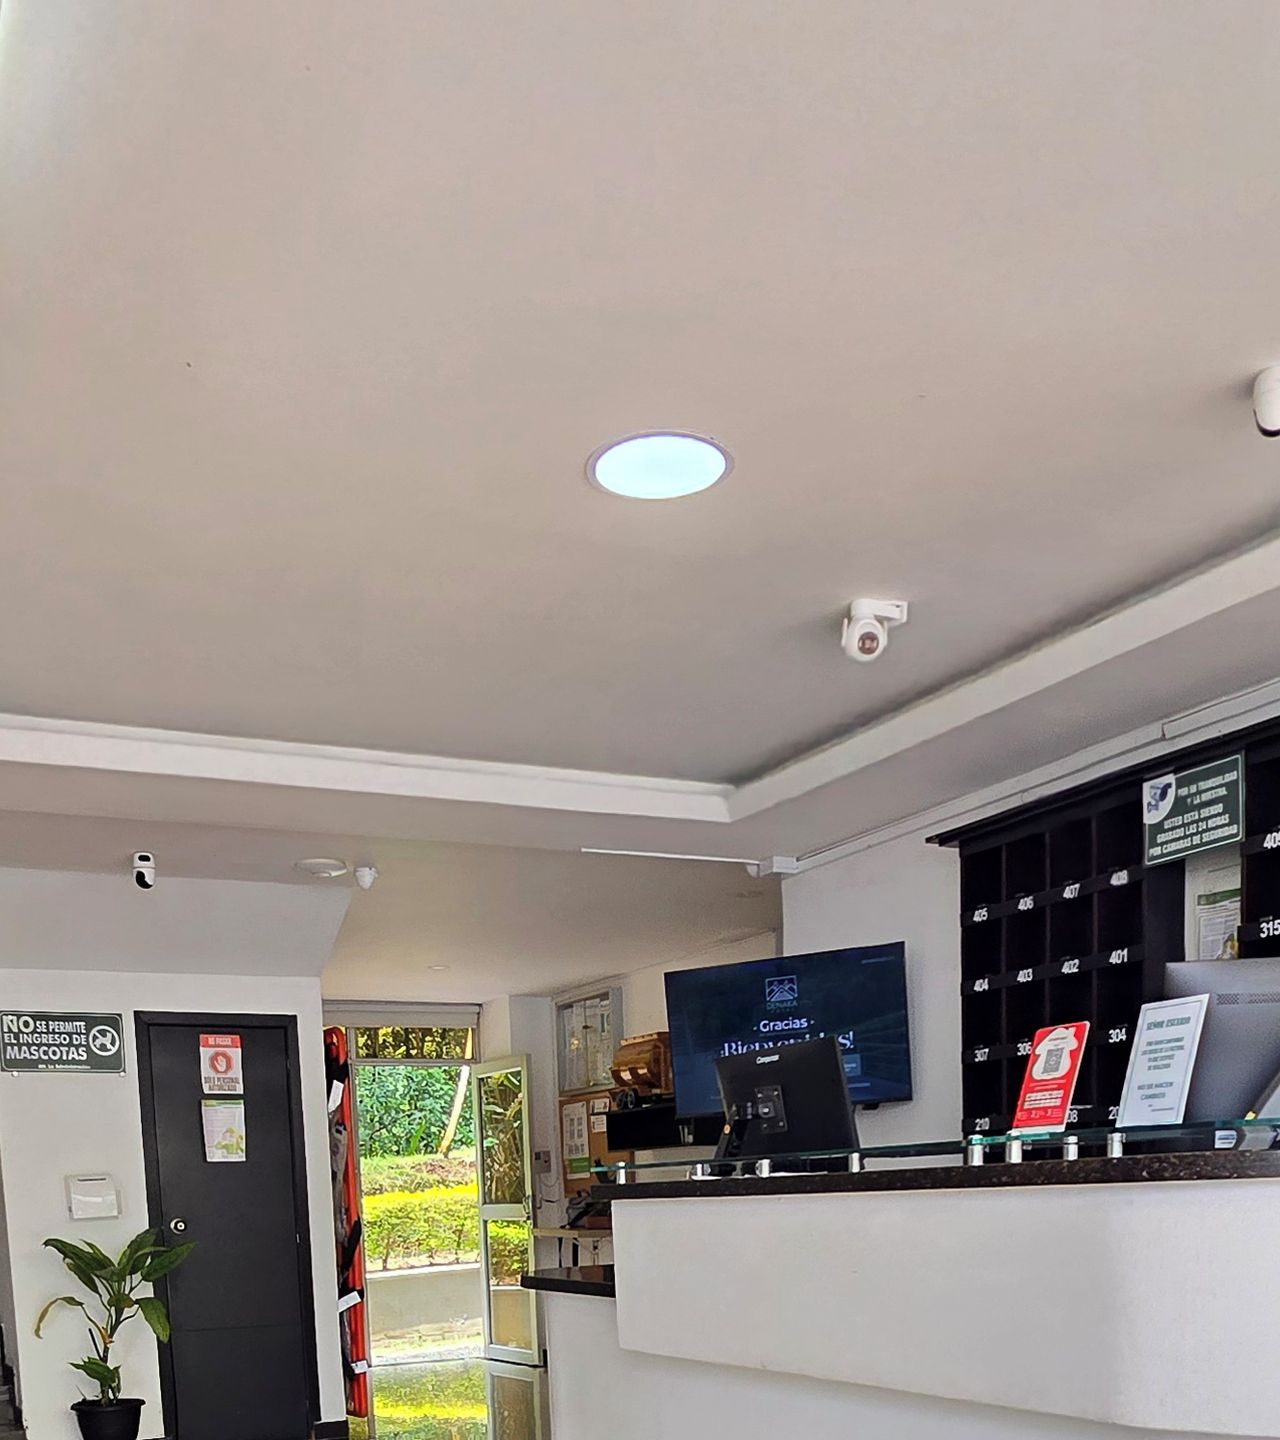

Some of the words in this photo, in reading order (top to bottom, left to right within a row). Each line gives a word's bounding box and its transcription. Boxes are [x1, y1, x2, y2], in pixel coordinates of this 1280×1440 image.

[1110, 869, 1128, 886] 408
[1063, 883, 1081, 899] 407
[1018, 896, 1034, 911] 406
[973, 908, 988, 922] 405
[1109, 948, 1128, 964] 401
[1061, 959, 1079, 974] 402
[1017, 968, 1033, 983] 403
[973, 978, 989, 992] 404
[1, 1014, 35, 1033] NO
[35, 1020, 47, 1033] SE
[48, 1021, 86, 1033] PERMITE
[759, 1017, 808, 1033] Gracias
[4, 1033, 17, 1043] EL
[19, 1033, 70, 1044] INGRESO
[72, 1034, 87, 1045] DE
[1108, 1028, 1127, 1042] 304
[5, 1045, 87, 1061] MASCOTAS
[974, 1048, 989, 1062] 307
[1017, 1042, 1032, 1056] 306
[1108, 1106, 1119, 1120] 20
[975, 1117, 990, 1131] 210
